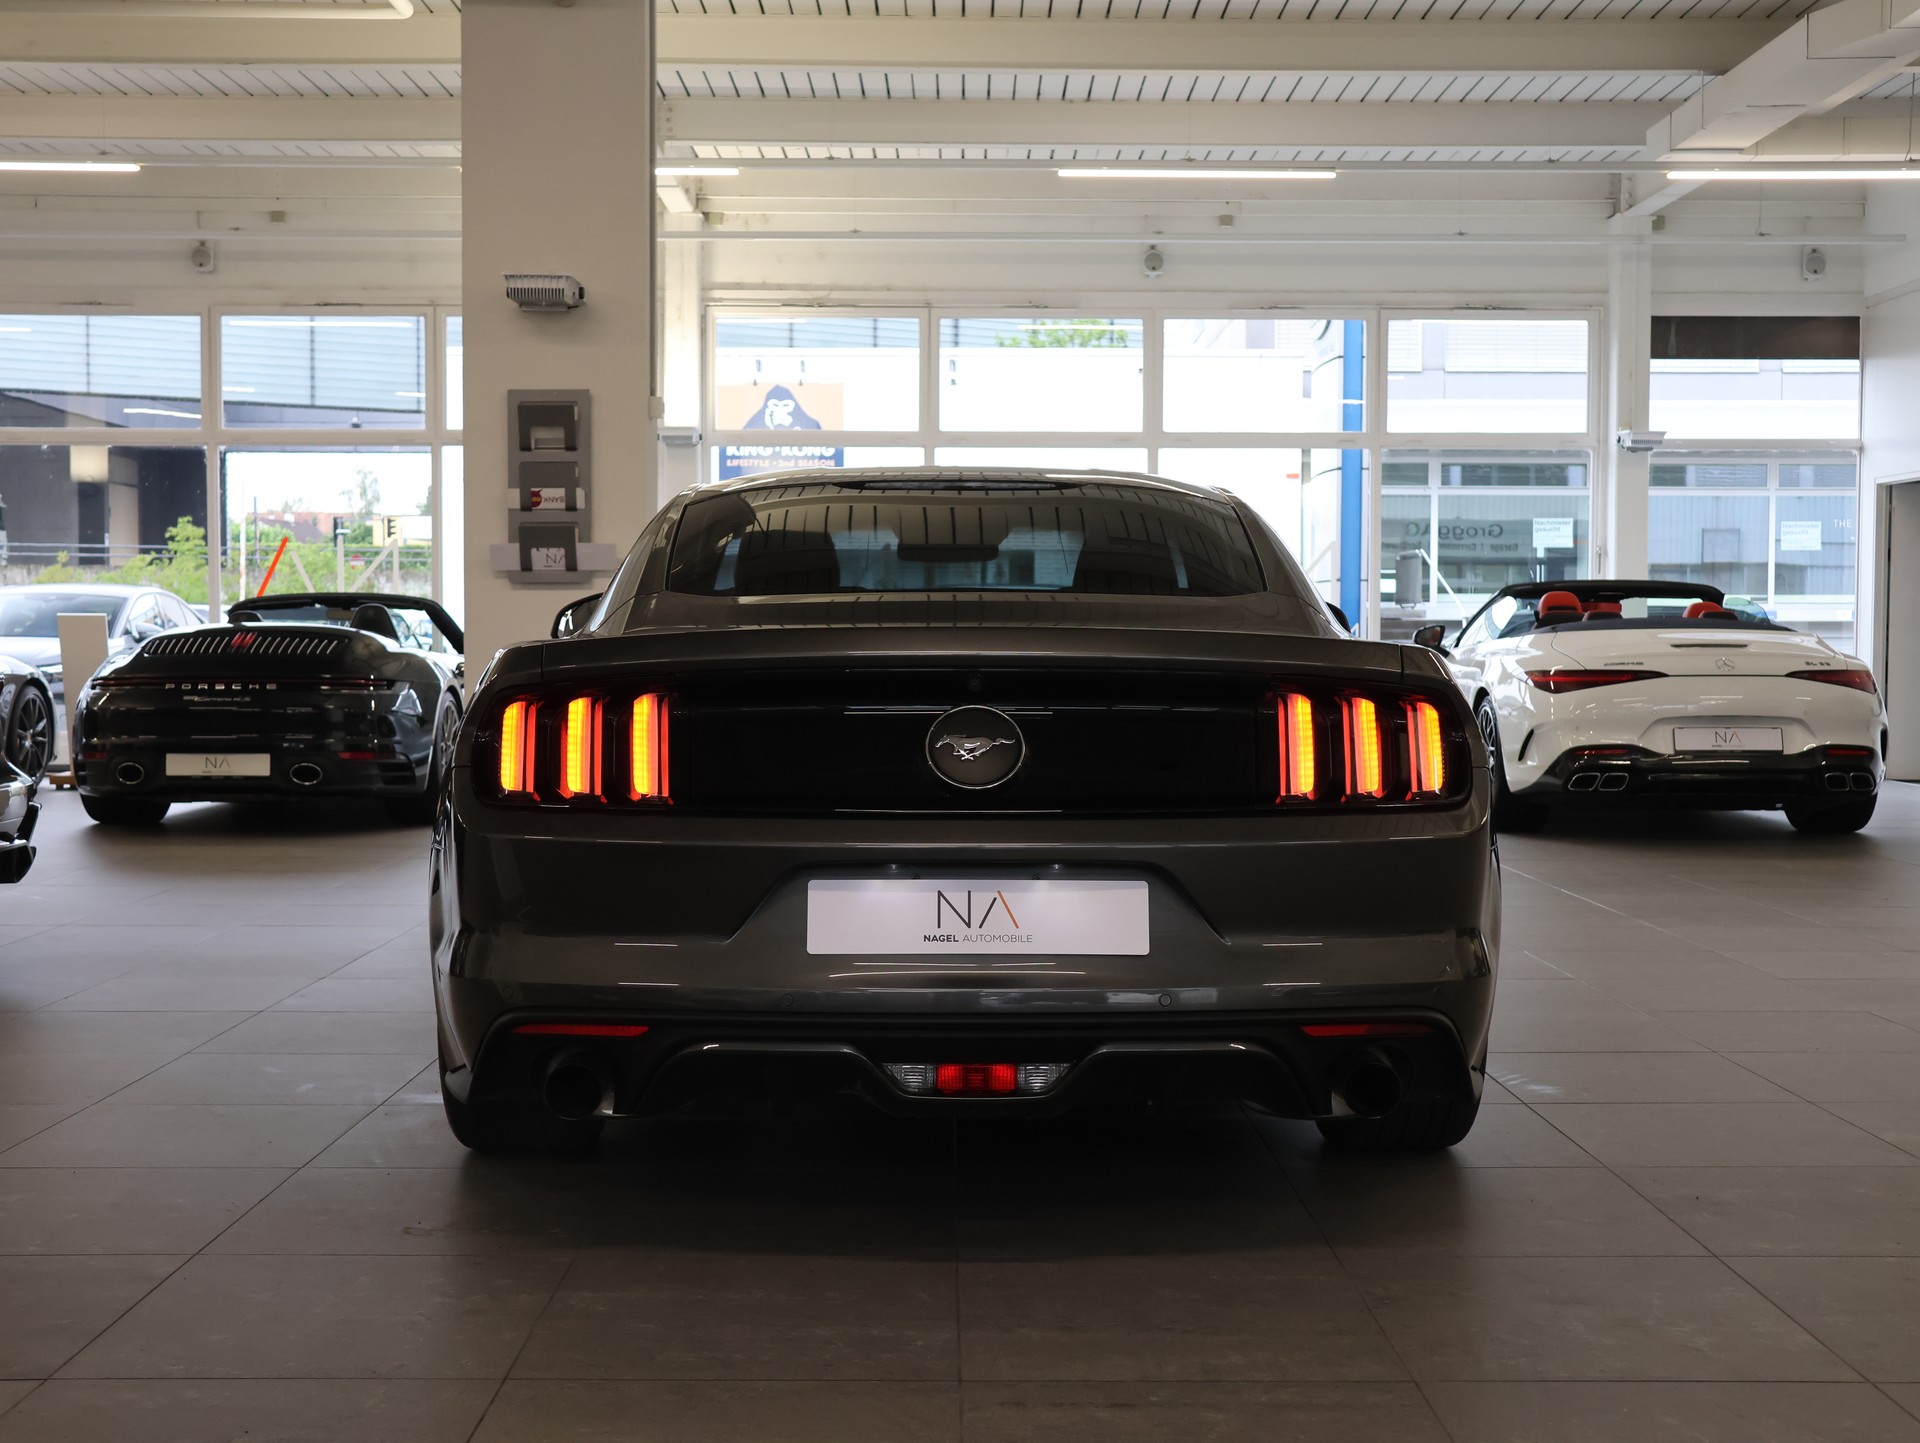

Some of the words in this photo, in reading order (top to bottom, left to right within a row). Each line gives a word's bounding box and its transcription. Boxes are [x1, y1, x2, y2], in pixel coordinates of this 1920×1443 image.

[1833, 519, 1853, 528] THE
[923, 934, 959, 943] NAGEL
[962, 934, 1033, 943] AUTOMOBILE
